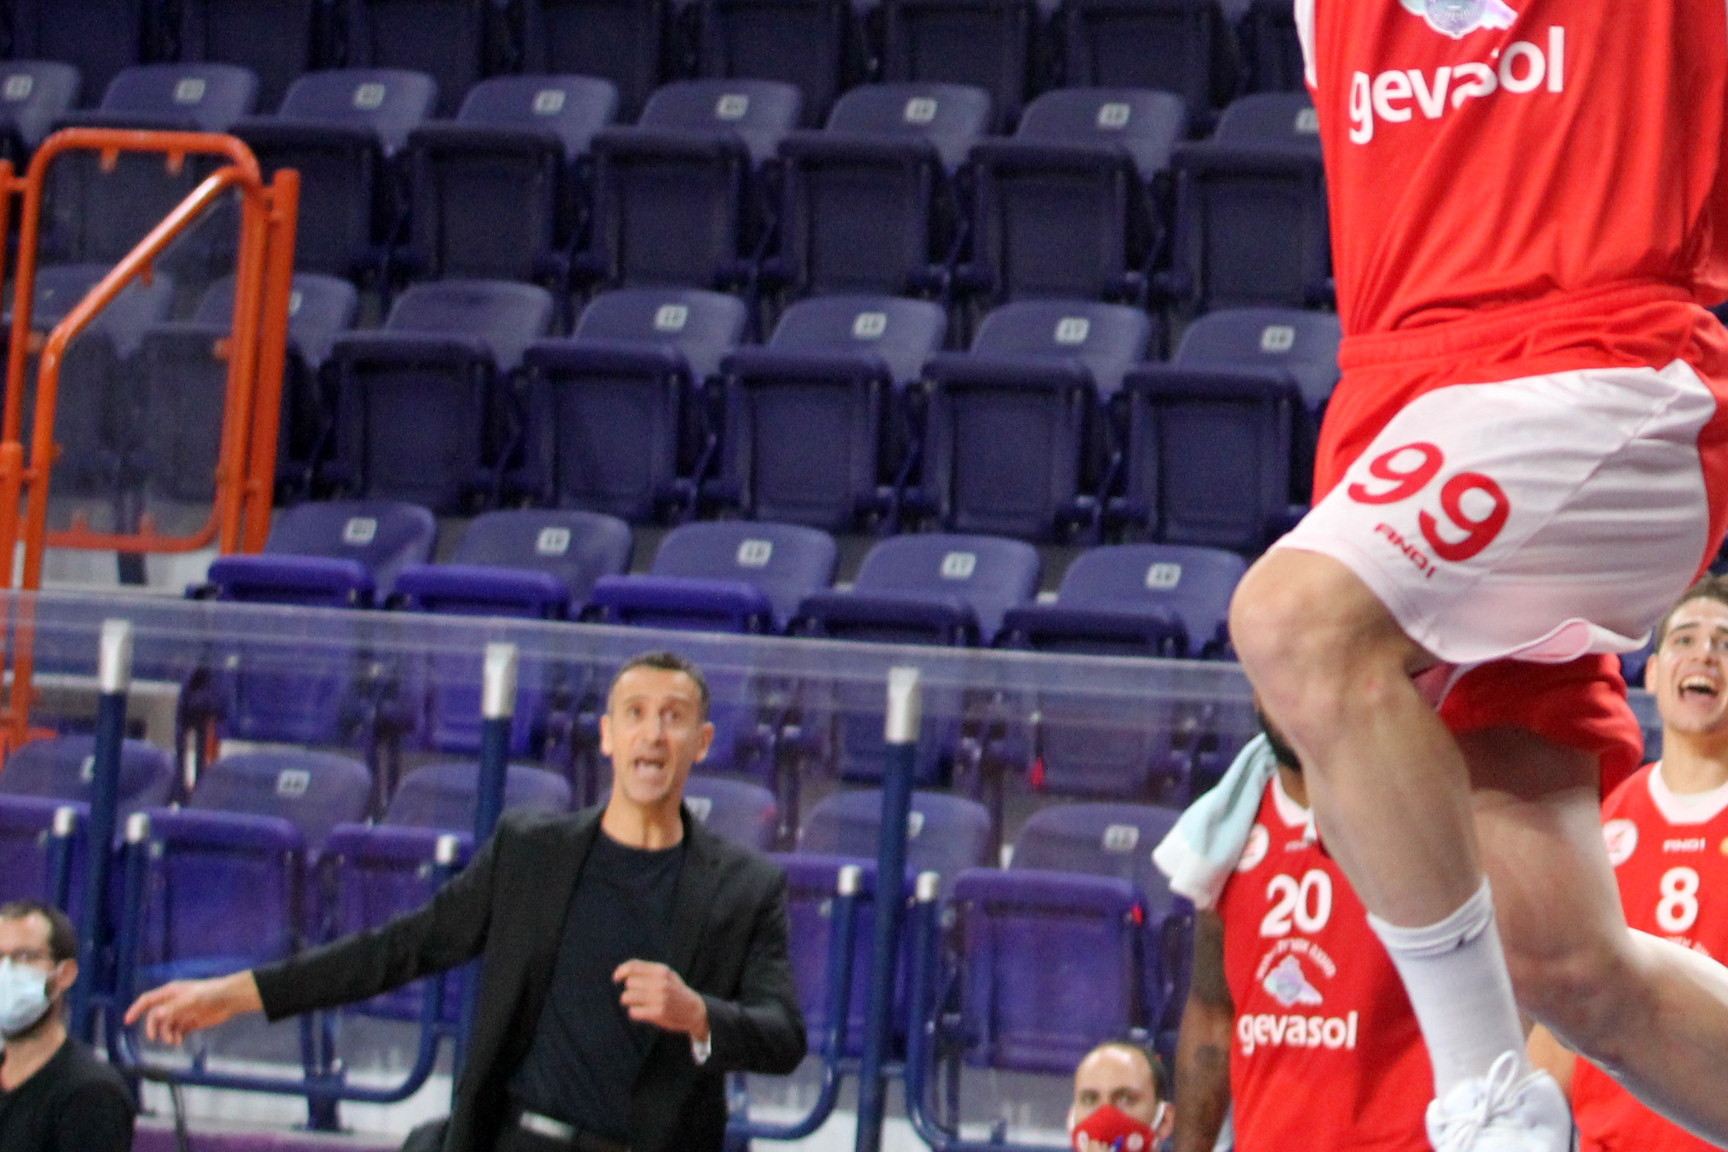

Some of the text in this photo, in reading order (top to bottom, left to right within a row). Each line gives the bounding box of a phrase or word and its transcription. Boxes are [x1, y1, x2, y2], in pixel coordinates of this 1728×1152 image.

[1348, 441, 1511, 562] 99
[1259, 868, 1333, 938] 20
[1655, 865, 1701, 934] 8
[1237, 1009, 1360, 1057] gevasol
